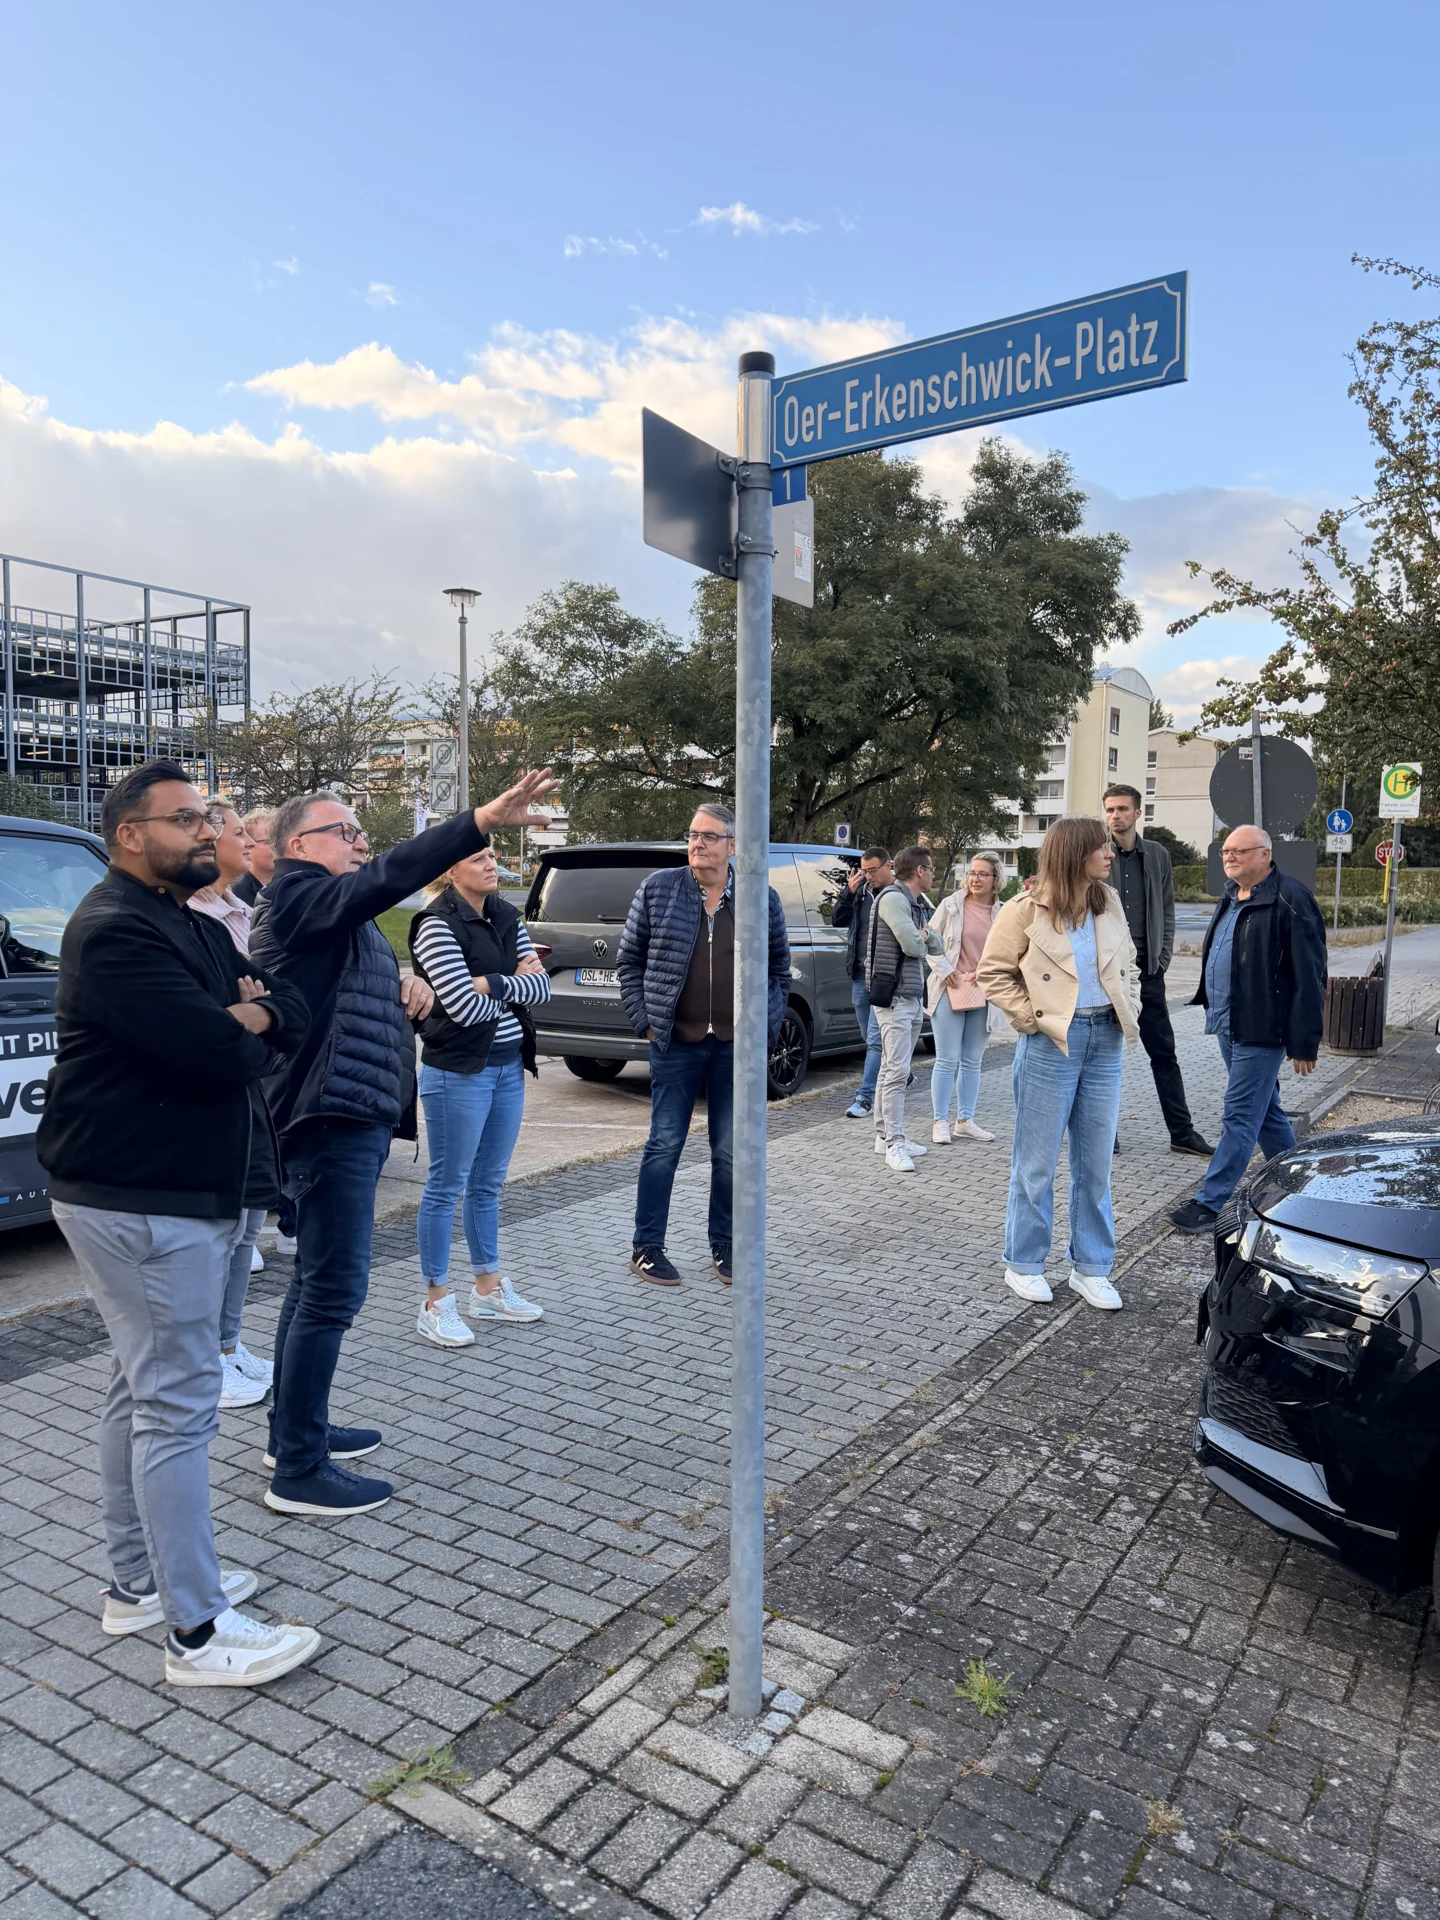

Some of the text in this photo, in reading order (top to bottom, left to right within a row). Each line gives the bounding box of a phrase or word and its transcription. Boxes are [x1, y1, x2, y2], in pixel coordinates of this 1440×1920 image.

[784, 312, 1159, 447] Oer-Erkenschwick-Platz
[782, 469, 791, 500] 1
[1378, 847, 1400, 858] STO
[581, 969, 597, 982] OSL
[603, 970, 615, 983] HE
